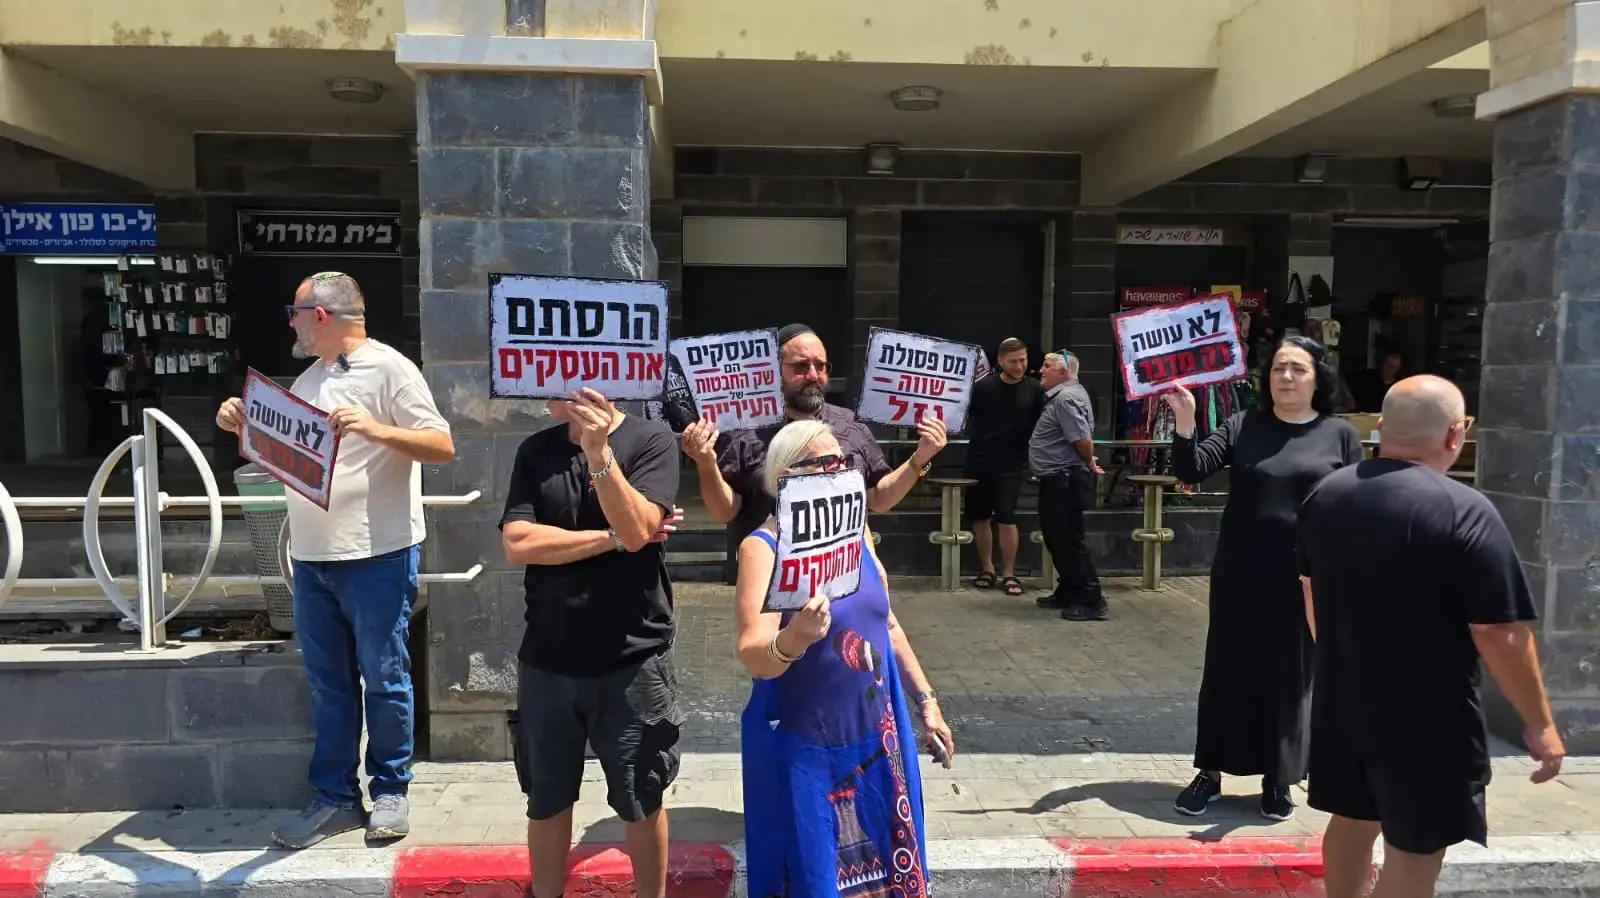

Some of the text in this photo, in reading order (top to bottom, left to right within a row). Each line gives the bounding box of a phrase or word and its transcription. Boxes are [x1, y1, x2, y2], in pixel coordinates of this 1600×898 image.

[2, 209, 156, 236] ל-בו פון אילן
[256, 222, 392, 244] בית מזרחי
[1125, 290, 1184, 303] havaianas
[506, 297, 659, 340] הרסתם
[1130, 308, 1221, 353] לא עושה
[686, 338, 770, 367] העסקים
[878, 343, 939, 371] פסולת
[942, 354, 968, 376] מס
[1138, 342, 1232, 380] רק מדבר
[498, 348, 620, 387] העסקים
[625, 352, 664, 381] את
[723, 363, 741, 374] הם
[752, 370, 775, 390] שק
[695, 373, 750, 394] החבטות
[729, 390, 744, 400] של
[898, 373, 946, 396] שווה
[701, 396, 778, 423] העירייה
[249, 399, 326, 450] לא עושה
[790, 491, 864, 544] הרסתם
[778, 540, 861, 598] את העסקים
